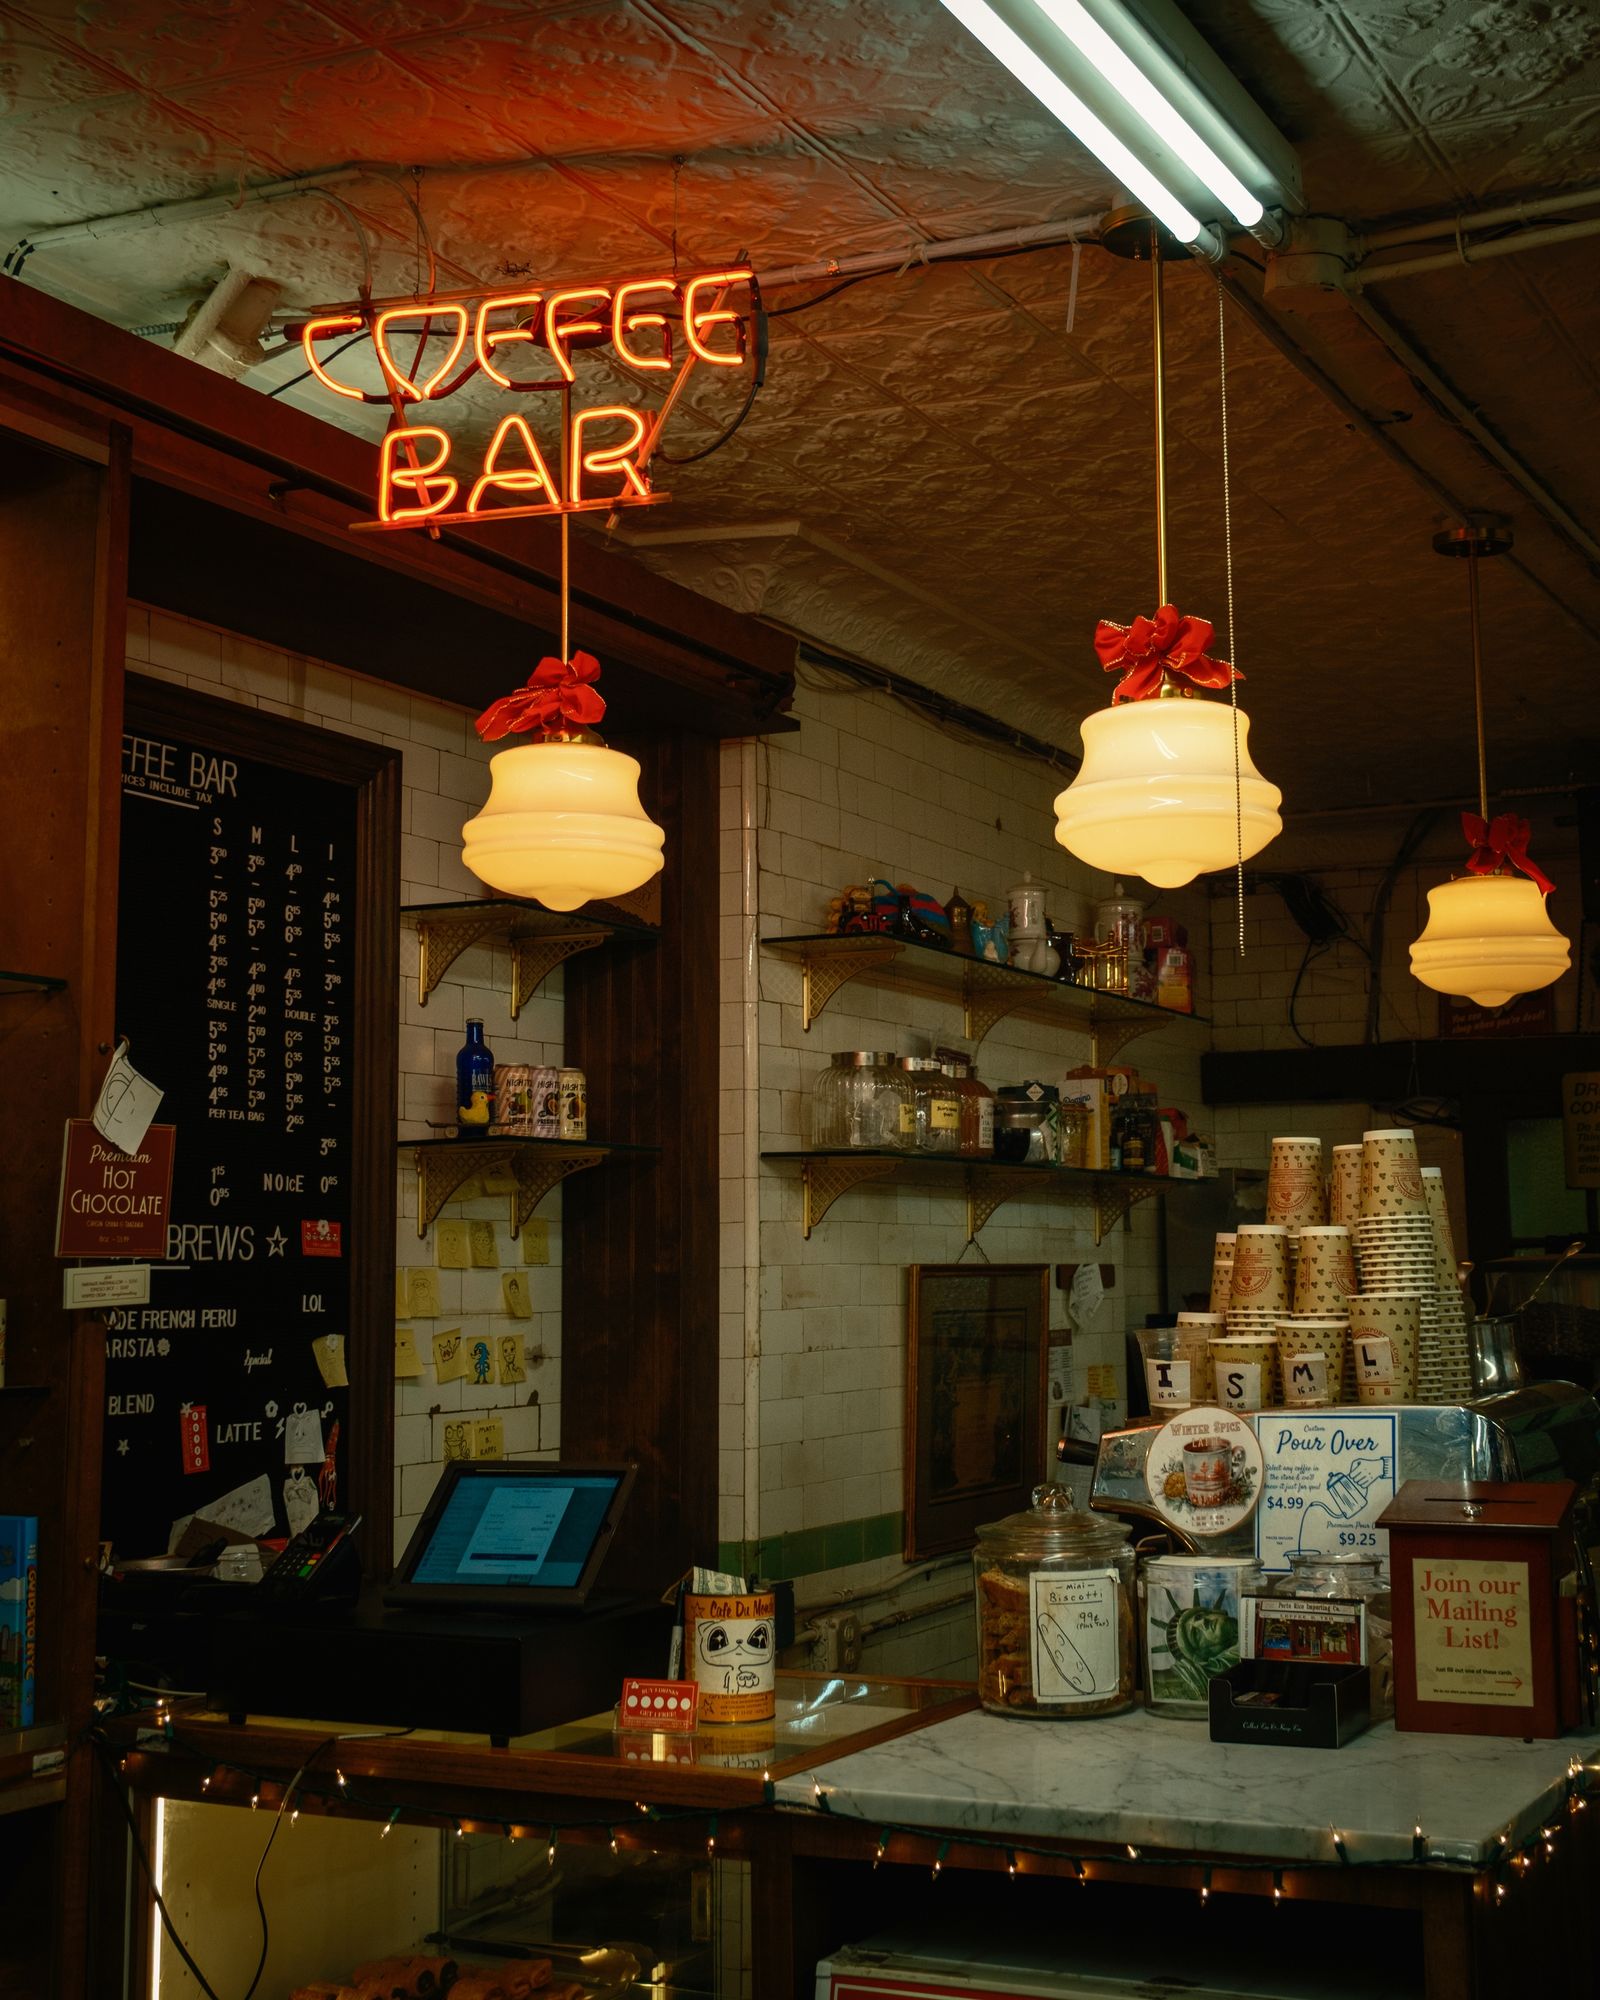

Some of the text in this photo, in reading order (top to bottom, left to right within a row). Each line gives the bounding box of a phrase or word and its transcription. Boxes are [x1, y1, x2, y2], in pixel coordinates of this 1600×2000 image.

[302, 269, 754, 400] COFFEE
[380, 405, 652, 521] BAR
[190, 752, 237, 798] BAR
[195, 791, 213, 804] TAX
[213, 817, 222, 835] S
[251, 825, 262, 845] M
[291, 835, 299, 853] L
[207, 998, 237, 1012] SINGLE
[285, 1009, 317, 1022] DOUBLE
[208, 1108, 265, 1122] PER TEA BAG
[103, 1165, 136, 1190] HOT
[71, 1189, 162, 1216] CHOCOLATE
[166, 1223, 255, 1261] BREWS
[141, 1309, 197, 1330] FRENCH
[201, 1308, 237, 1329] PERU
[1361, 1344, 1377, 1367] L
[1155, 1362, 1174, 1388] I
[1292, 1362, 1314, 1382] M
[1226, 1371, 1244, 1399] S
[108, 1394, 155, 1416] BLEND
[217, 1421, 263, 1444] LATTE
[1213, 1421, 1241, 1434] SPICE
[1276, 1429, 1379, 1455] Pour Over
[1267, 1495, 1304, 1510] $4.99
[1339, 1531, 1376, 1546] $9.25
[1065, 1582, 1085, 1590] Mini
[1420, 1570, 1521, 1595] Join our
[1049, 1591, 1103, 1603] Biscotti
[1426, 1598, 1518, 1628] Mailing
[1443, 1626, 1500, 1650] List!
